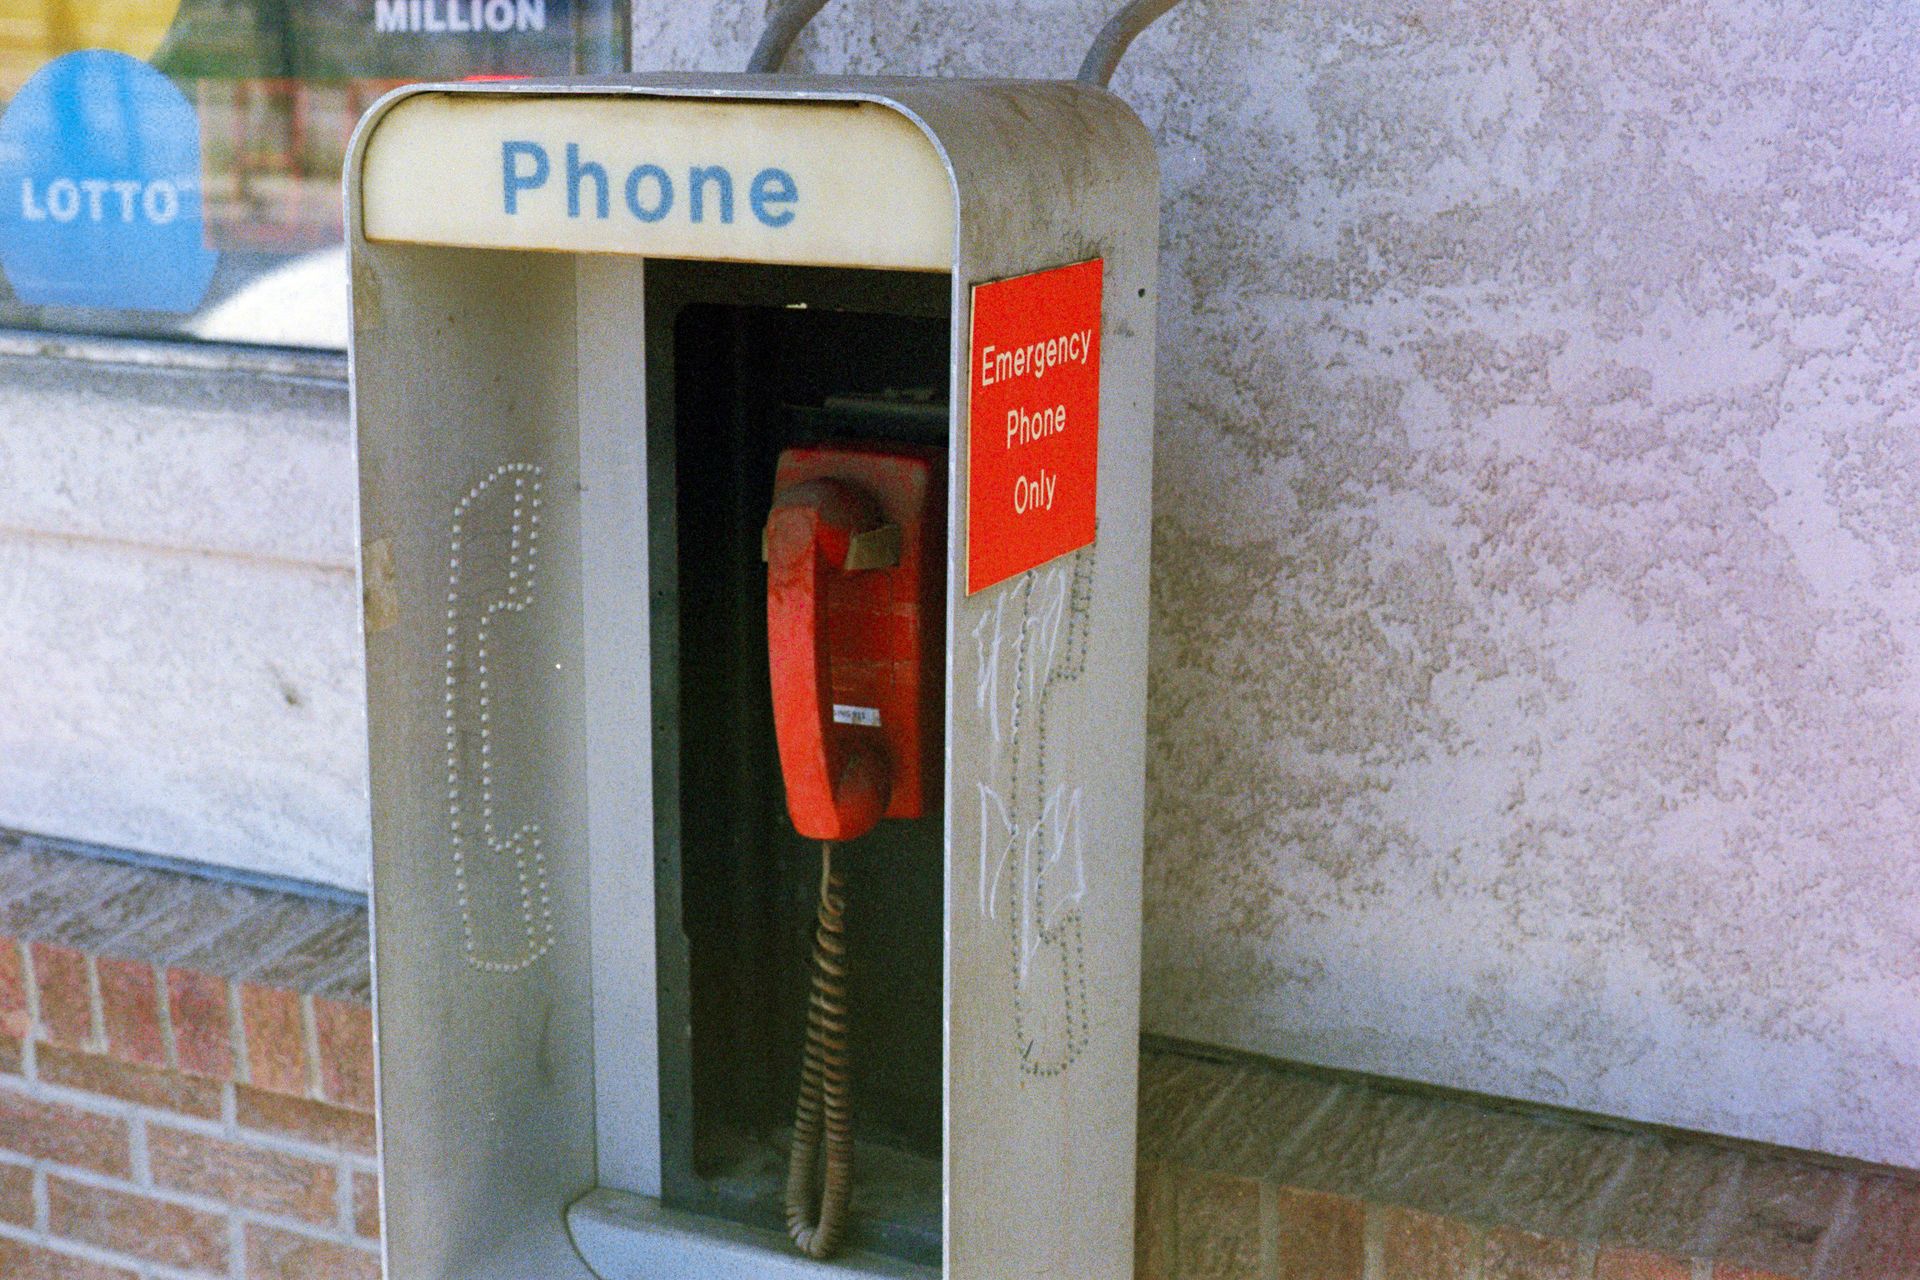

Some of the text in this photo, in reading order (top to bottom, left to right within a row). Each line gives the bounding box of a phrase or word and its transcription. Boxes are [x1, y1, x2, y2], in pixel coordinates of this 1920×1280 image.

[374, 0, 546, 31] MILLION
[21, 177, 179, 223] LOTTO
[502, 140, 799, 228] Phone
[981, 329, 1092, 387] Emergency
[1006, 404, 1067, 449] Phone
[1013, 469, 1057, 515] Only
